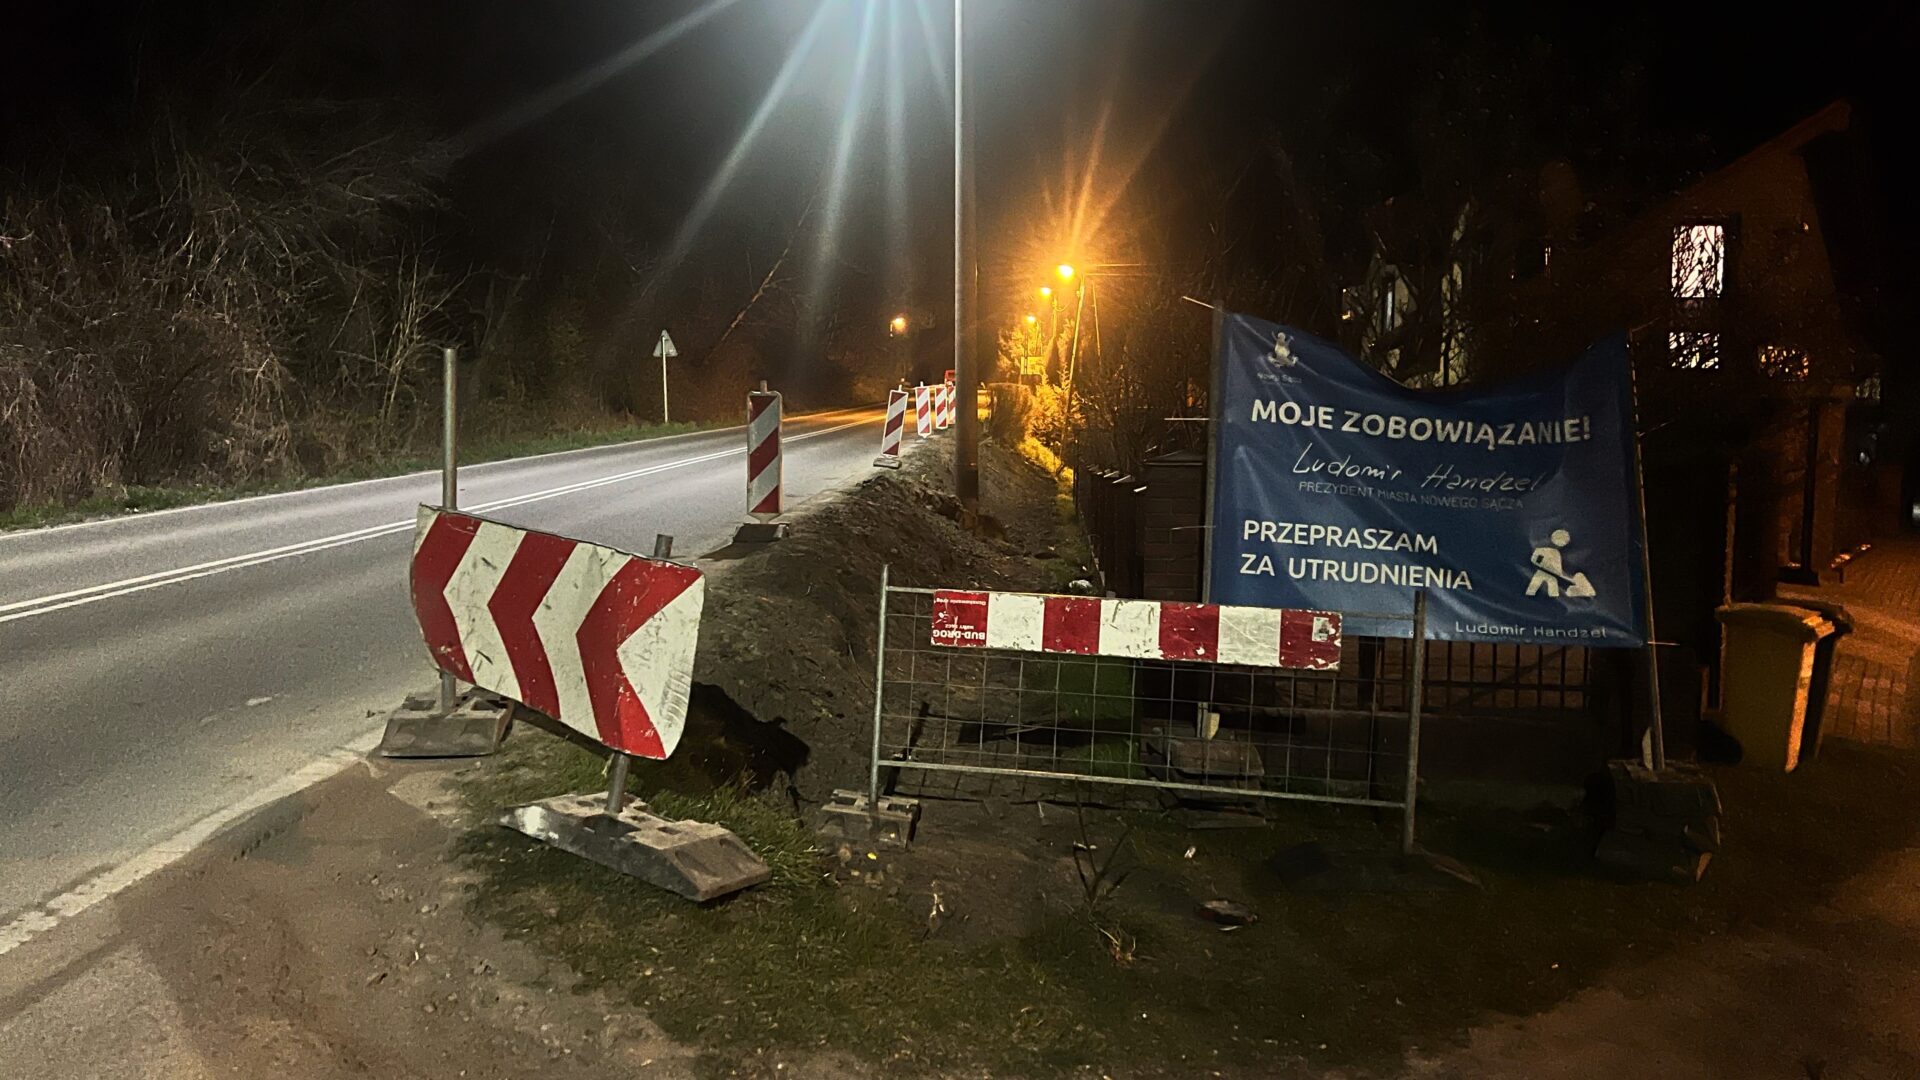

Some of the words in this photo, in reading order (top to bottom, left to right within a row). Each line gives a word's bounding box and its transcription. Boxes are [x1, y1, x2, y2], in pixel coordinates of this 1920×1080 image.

[1251, 399, 1335, 429] MOJE
[1341, 411, 1591, 450] ZOBOWIĄZANIE!
[1293, 442, 1402, 480] Ludomir
[1420, 463, 1547, 492] Handzel
[1298, 481, 1374, 497] PREZYDENT
[1377, 489, 1418, 503] MIASTA
[1420, 494, 1478, 509] NOWEGO
[1481, 497, 1524, 512] SĄCZA
[1243, 519, 1438, 555] PRZEPRASZAM
[1239, 553, 1275, 577] ZA
[1288, 557, 1473, 590] UTRUDNIENIA
[932, 629, 986, 640] BUD-DROG
[1455, 621, 1526, 636] Ludomir
[1534, 625, 1607, 638] Handzel
